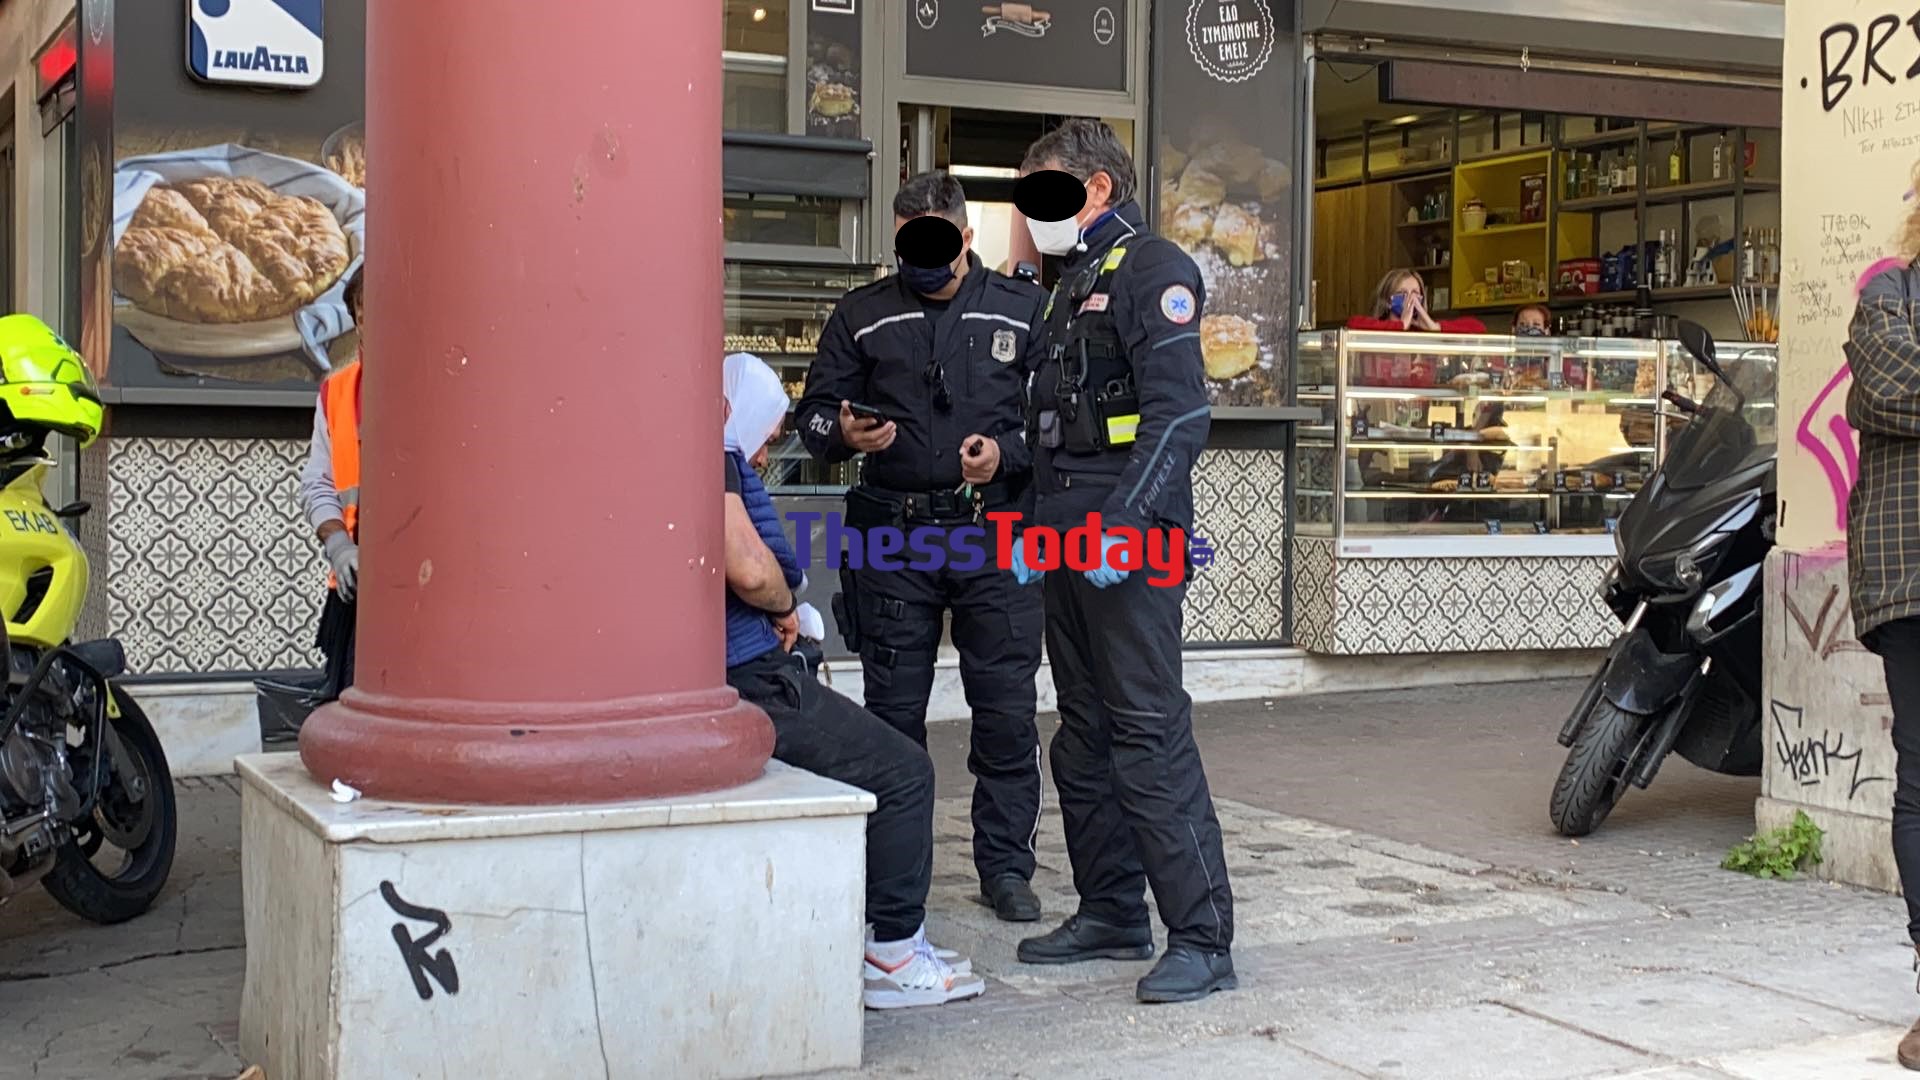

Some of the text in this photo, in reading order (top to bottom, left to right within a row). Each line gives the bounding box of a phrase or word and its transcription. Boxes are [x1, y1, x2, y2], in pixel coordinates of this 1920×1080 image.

[1219, 4, 1238, 23] ΕΔΩ
[1202, 21, 1260, 44] ΖΥΜΩΝΟΥΜΕ
[213, 45, 309, 74] LAVAZZA
[1219, 41, 1249, 61] ΕΜΕΙΣ
